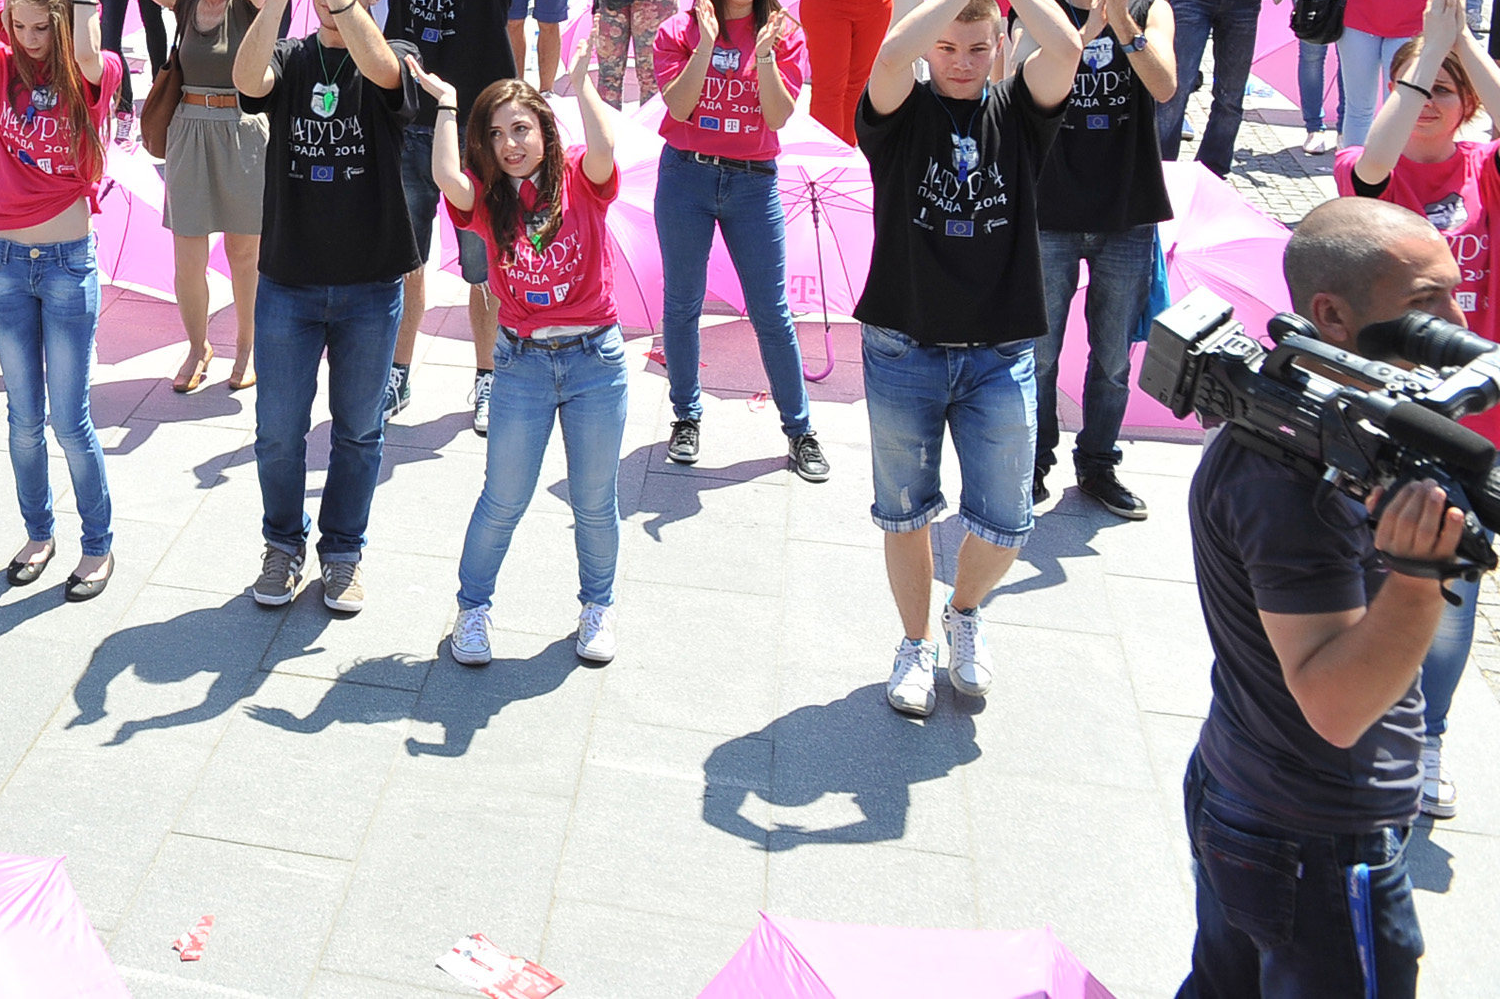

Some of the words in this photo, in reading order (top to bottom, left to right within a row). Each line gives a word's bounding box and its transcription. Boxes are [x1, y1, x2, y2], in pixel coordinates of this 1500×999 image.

[2, 130, 35, 151] АРАДА
[44, 144, 70, 154] 201
[334, 144, 366, 157] 2014
[974, 193, 1008, 212] 2014
